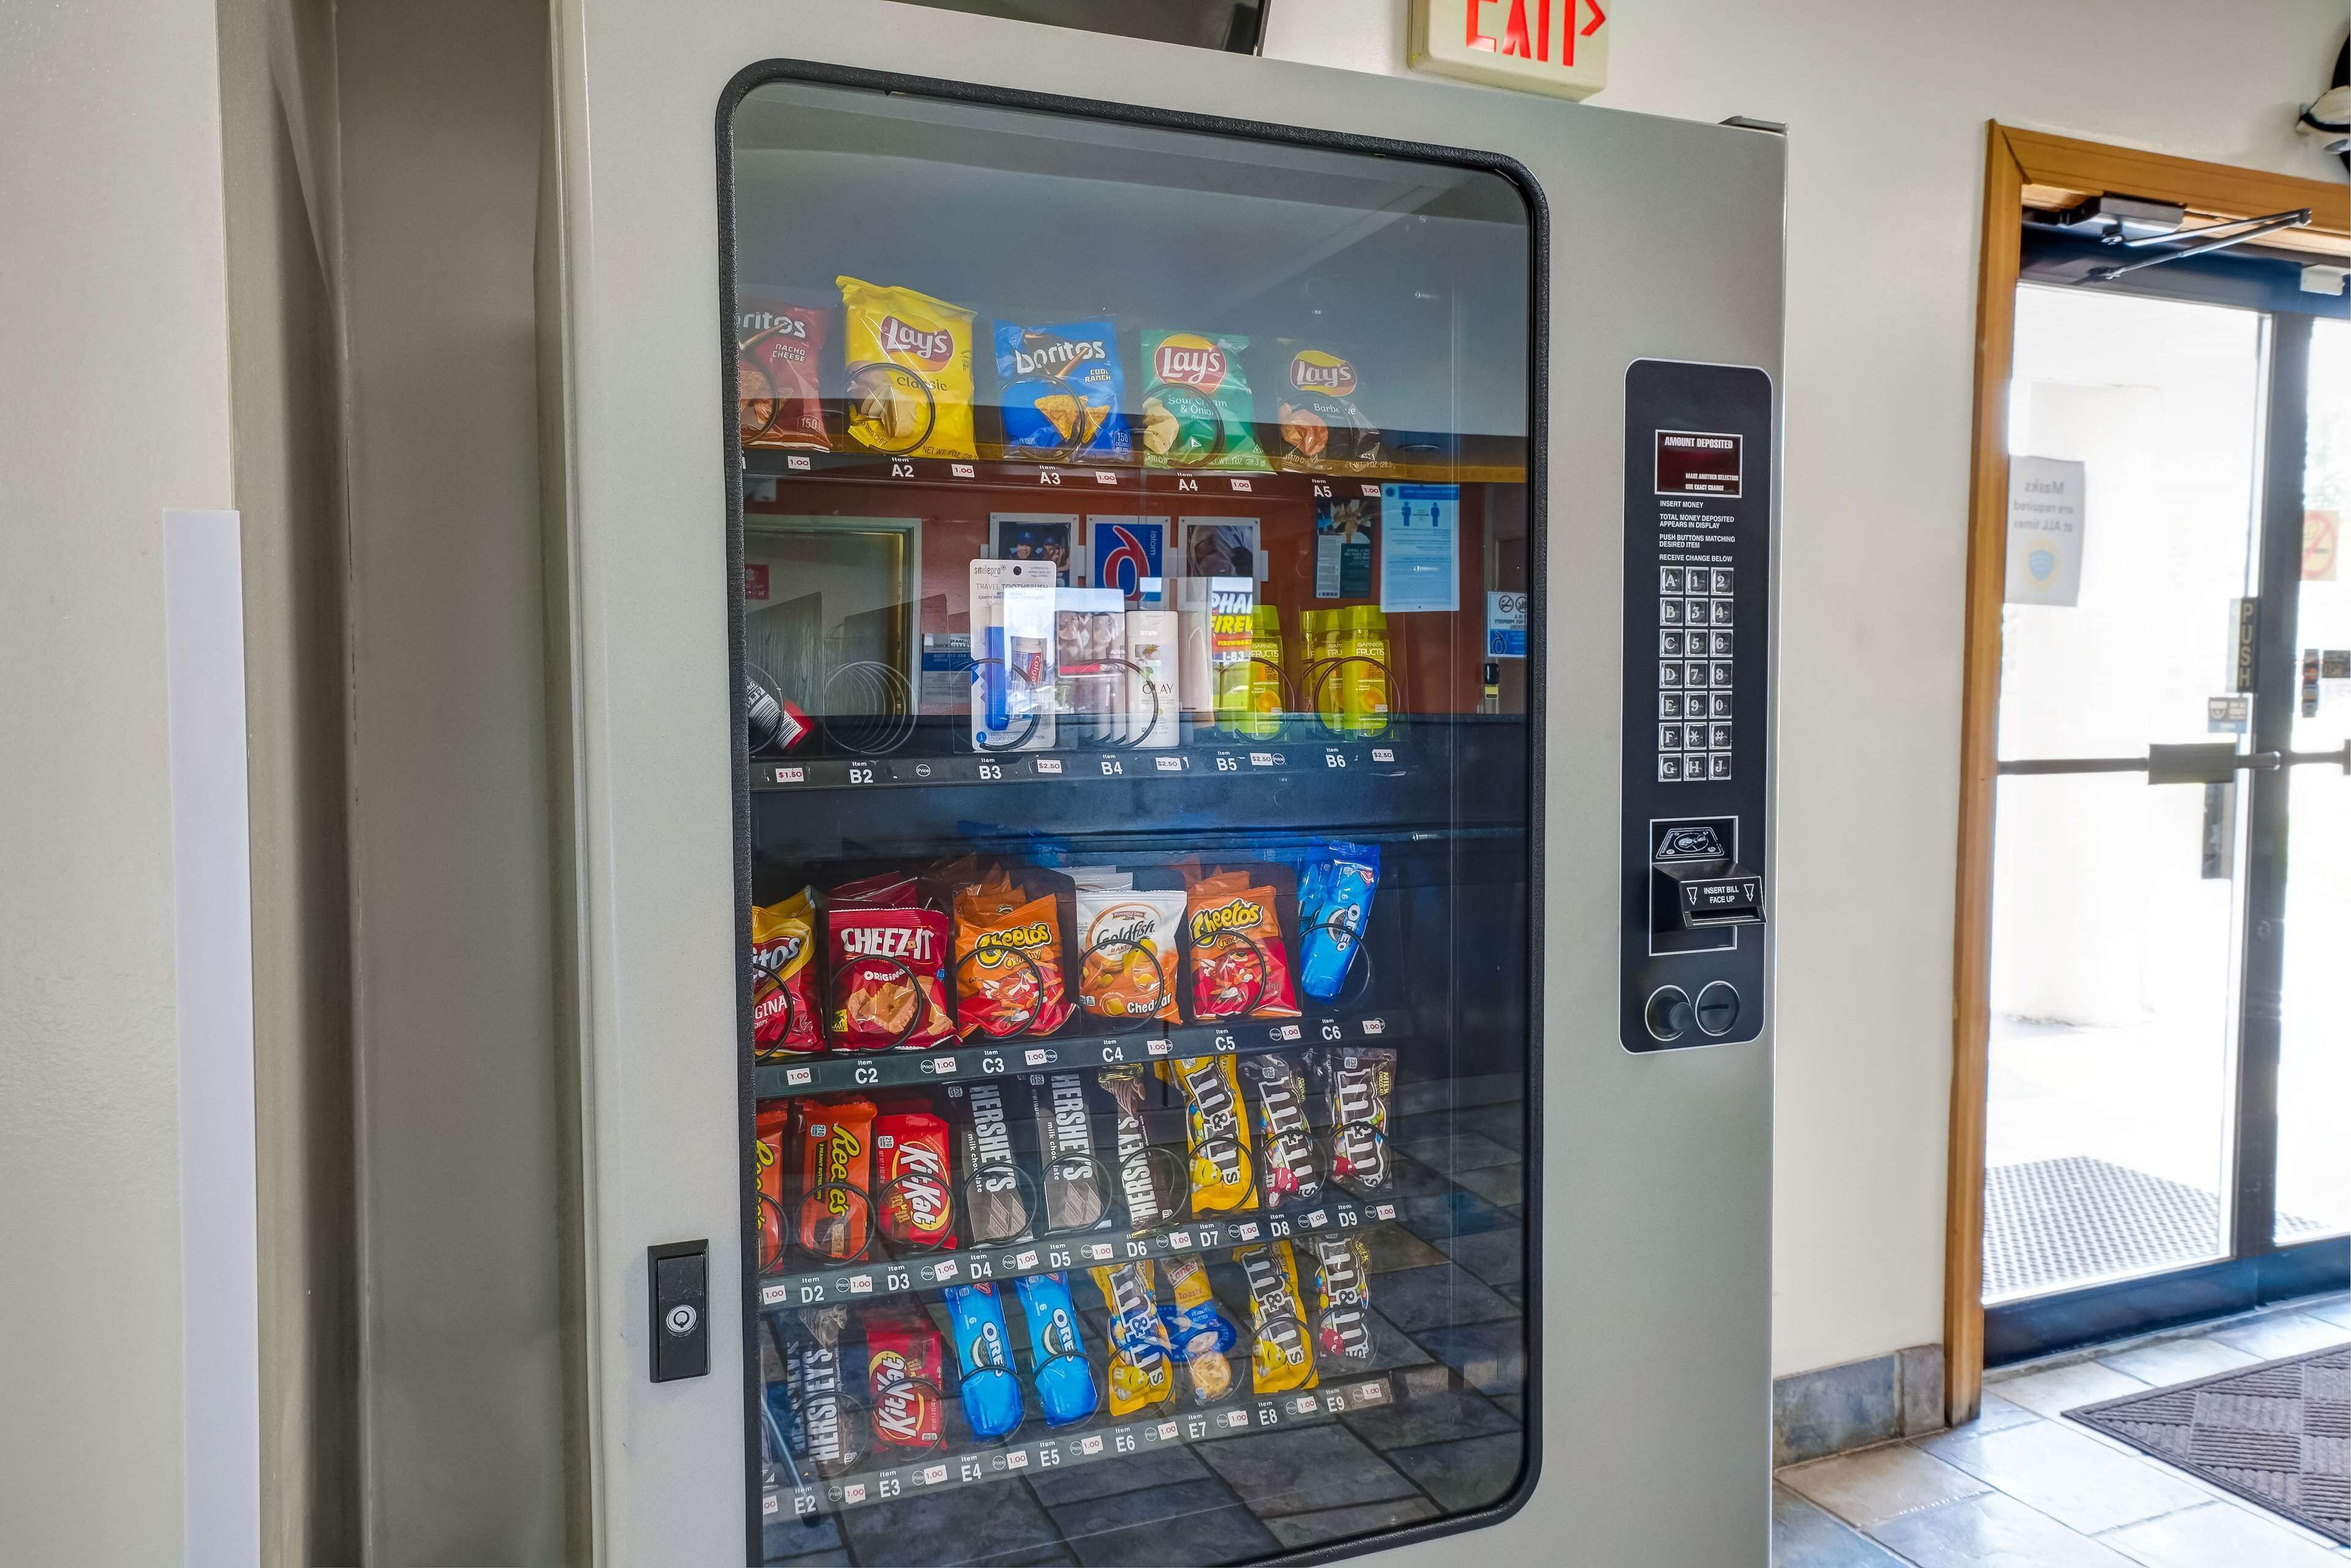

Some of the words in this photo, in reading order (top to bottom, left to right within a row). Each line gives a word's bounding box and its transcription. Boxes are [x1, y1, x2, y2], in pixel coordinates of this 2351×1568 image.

[739, 312, 806, 339] ritos
[886, 318, 947, 359] Lay's
[772, 350, 805, 362] CHEESE
[775, 344, 805, 356] NACHO
[1015, 341, 1105, 373] Doritos
[1162, 348, 1221, 384] Lay's
[1297, 360, 1352, 387] Lay's
[897, 377, 948, 391] Clasic
[801, 417, 818, 429] 150
[1117, 432, 1128, 442] 150
[1665, 437, 1695, 447] AMOUNT
[1696, 438, 1733, 449] DEPOSITED
[922, 445, 935, 454] NET
[892, 464, 914, 477] A2
[1040, 473, 1061, 484] A3
[1179, 479, 1198, 491] A4
[1314, 486, 1332, 497] A5
[974, 565, 1001, 576] smilepro
[1665, 575, 1676, 587] A
[1693, 576, 1699, 587] 1
[1717, 576, 1725, 587] 2
[1665, 637, 1676, 649] C
[1691, 637, 1699, 649] 5
[1716, 637, 1723, 649] 6
[2240, 603, 2254, 686] PUSH
[1143, 684, 1174, 694] OAY
[1665, 699, 1675, 711] E
[1691, 700, 1699, 711] 9
[1715, 700, 1723, 711] 0
[1100, 762, 1123, 775] B4
[1216, 758, 1237, 771] B5
[1325, 754, 1346, 767] B6
[1663, 762, 1674, 773] G
[1689, 762, 1699, 773] H
[1715, 761, 1723, 772] J
[850, 769, 873, 784] B2
[979, 765, 1002, 779] B3
[1192, 900, 1262, 945] Cheetos
[1336, 904, 1360, 951] OREO
[1097, 920, 1155, 948] Goldfish
[841, 927, 935, 960] CHEEZ-IT
[976, 924, 1051, 966] Cheetos
[753, 937, 801, 978] itos
[1322, 1026, 1341, 1040] C6
[1216, 1037, 1235, 1051] C5
[1103, 1047, 1124, 1062] C4
[983, 1058, 1004, 1073] C3
[856, 1068, 878, 1084] C2
[1051, 1074, 1093, 1180] HERSHEY'S
[969, 1084, 1017, 1191] HERSHEY'S
[829, 1125, 861, 1217] Reee's
[1118, 1116, 1158, 1223] HERSHEY'S
[899, 1144, 942, 1226] KitKat
[1338, 1212, 1358, 1227] D9
[1270, 1221, 1290, 1237] D8
[1200, 1231, 1219, 1247] D7
[1127, 1241, 1147, 1257] D6
[1050, 1252, 1071, 1268] D5
[938, 1265, 955, 1274] 1.00
[970, 1262, 992, 1279] D4
[1171, 1261, 1196, 1285] Lance
[887, 1274, 910, 1291] D3
[801, 1286, 824, 1304] D2
[1191, 1308, 1208, 1316] PEANUT
[1192, 1314, 1209, 1322] BUTTER
[803, 1348, 840, 1462] HERSHEY'S
[877, 1356, 917, 1438] KitKat
[1326, 1396, 1345, 1412] E9
[1258, 1408, 1279, 1426] E8
[1189, 1422, 1207, 1438] E7
[1116, 1435, 1135, 1452] E6
[1040, 1449, 1059, 1466] E5
[961, 1463, 982, 1482] E4
[879, 1479, 900, 1498] E3
[794, 1495, 816, 1514] E2
